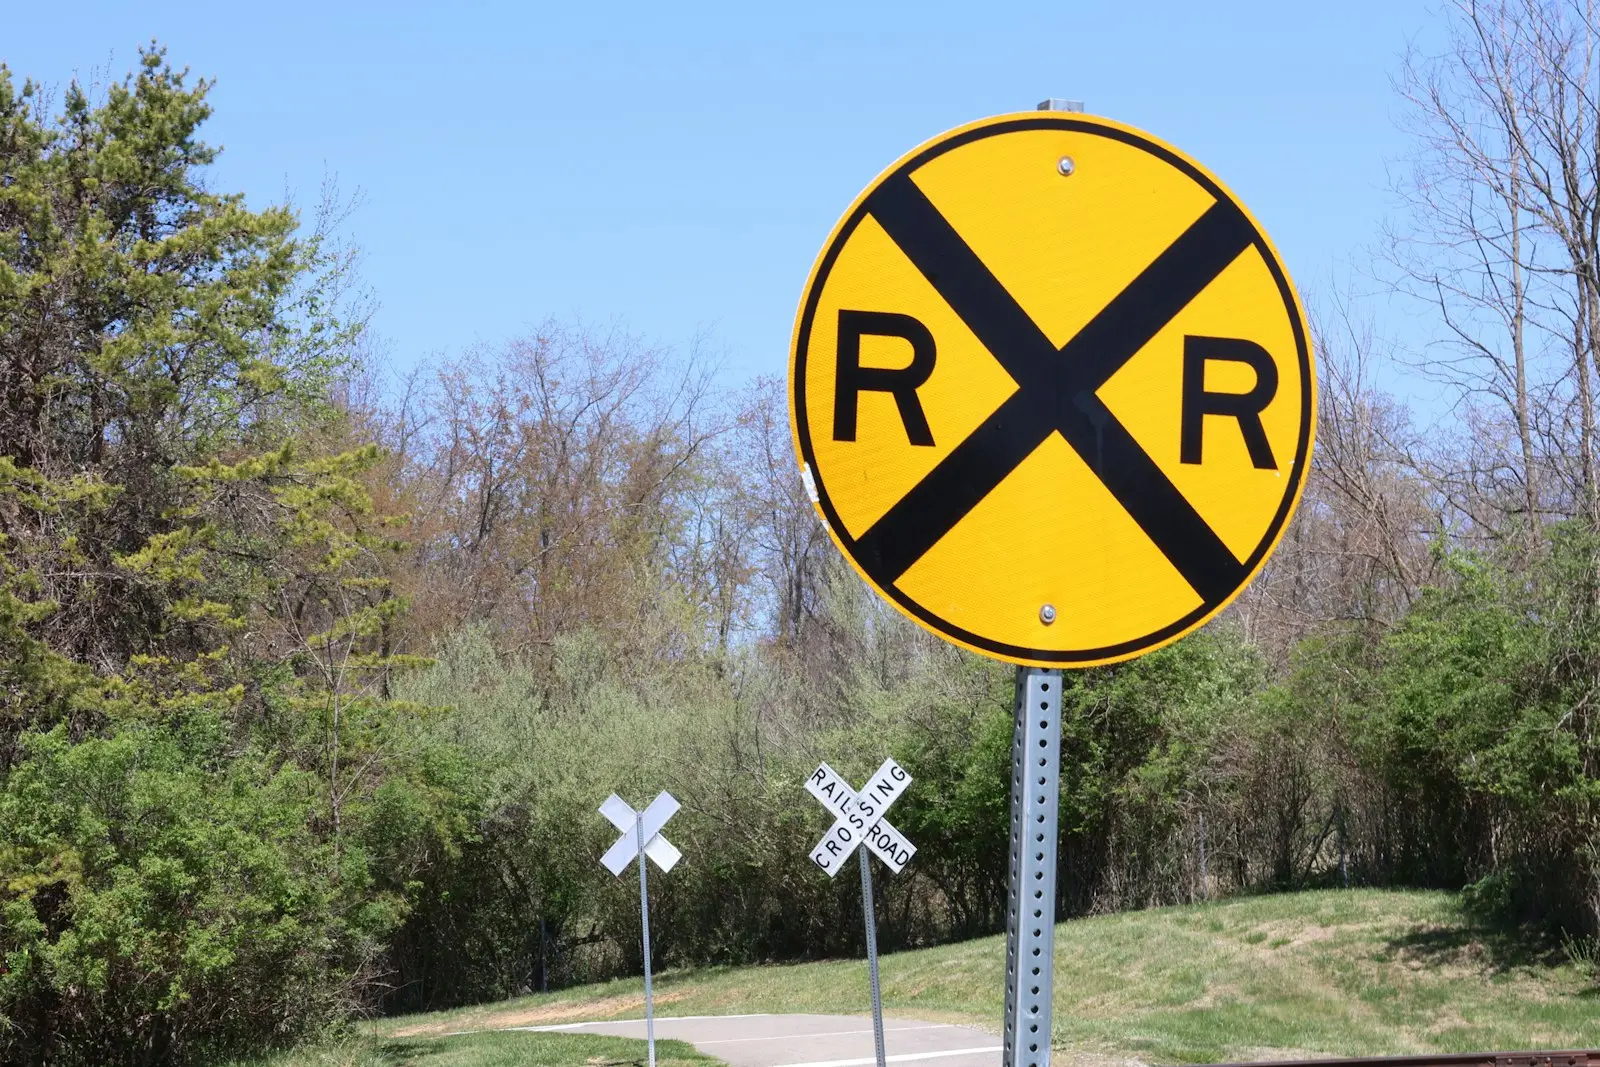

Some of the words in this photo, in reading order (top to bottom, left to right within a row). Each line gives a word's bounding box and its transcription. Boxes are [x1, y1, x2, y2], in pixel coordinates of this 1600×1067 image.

[833, 309, 936, 447] R
[1180, 335, 1279, 470] R
[811, 768, 851, 815] RAIL
[864, 824, 909, 866] ROAD
[815, 766, 906, 869] CROSSING
